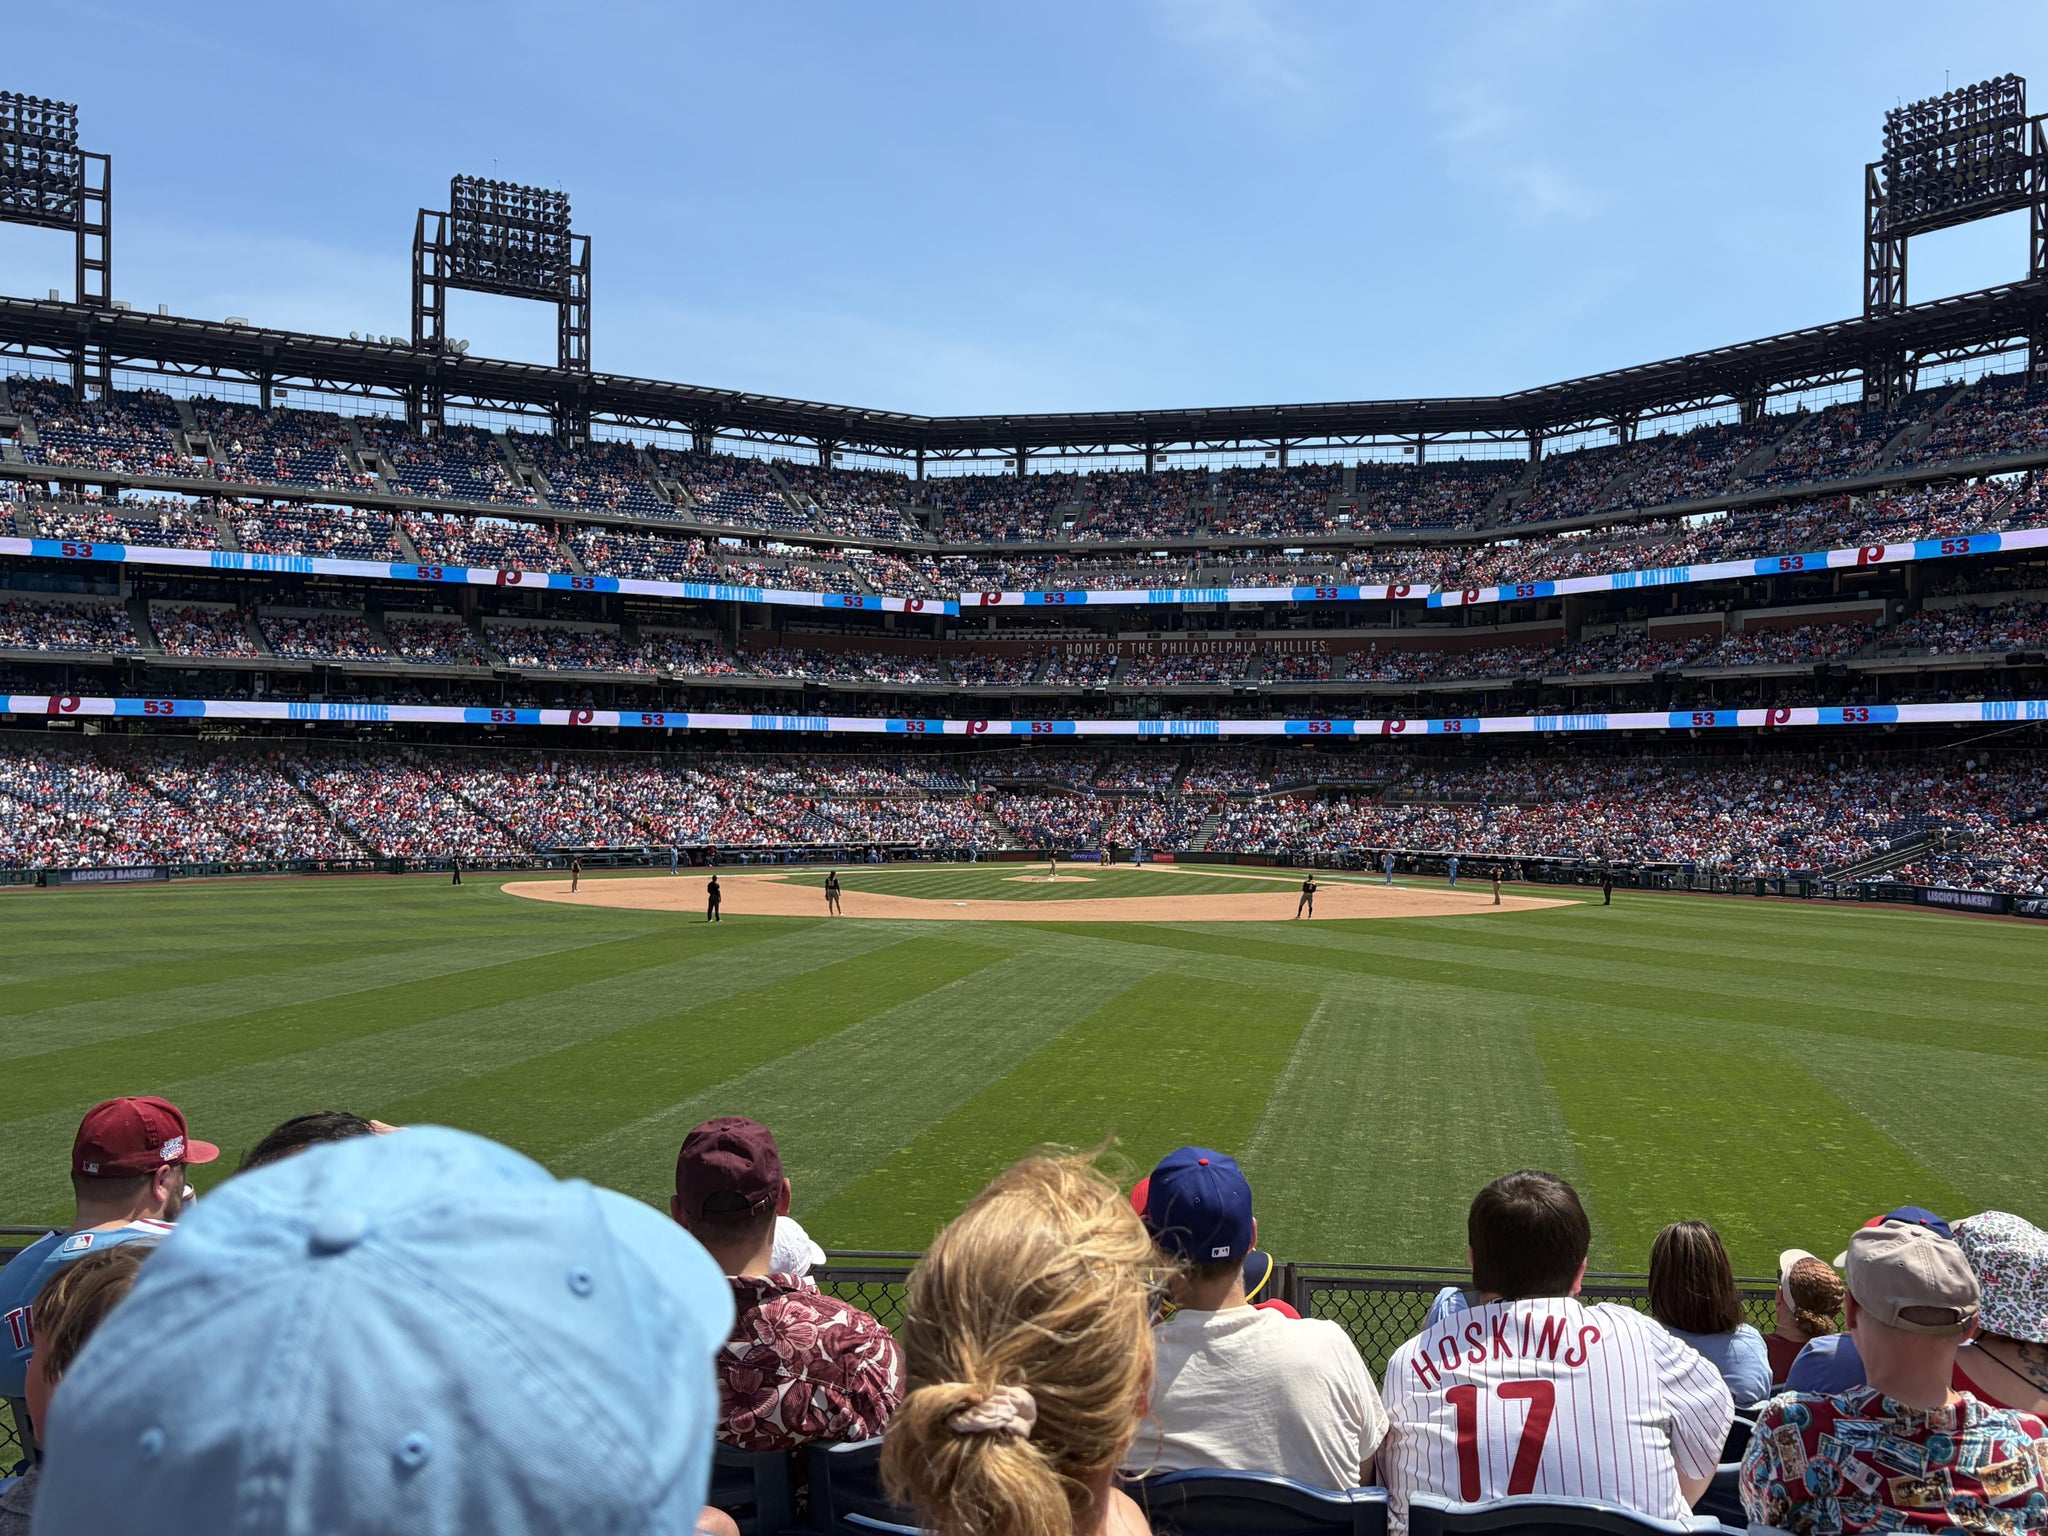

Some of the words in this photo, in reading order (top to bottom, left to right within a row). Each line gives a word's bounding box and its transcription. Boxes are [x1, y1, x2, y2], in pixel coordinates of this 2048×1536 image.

[62, 543, 93, 558] 53
[1941, 539, 1969, 554] 53
[211, 552, 247, 567] NOW
[252, 555, 312, 573] BATTING
[1779, 556, 1803, 570] 53
[417, 567, 442, 579] 53
[1612, 571, 1636, 588] NOW
[1640, 567, 1689, 585] BATTING
[571, 577, 594, 588] 53
[684, 584, 709, 598] NOW
[716, 586, 763, 601] BATTING
[1149, 589, 1175, 602] NOW
[1180, 588, 1228, 602] BATTING
[1316, 588, 1338, 598] 53
[1516, 585, 1534, 597] 53
[844, 596, 862, 607] 53
[1044, 593, 1065, 603] 53
[1066, 642, 1101, 654] HOME
[1108, 642, 1123, 654] OF
[1131, 642, 1153, 654] THE
[1162, 641, 1257, 654] PHILADELPHIA
[145, 701, 174, 714] 53
[288, 703, 324, 718] NOW
[329, 704, 388, 720] BATTING
[1982, 702, 2020, 720] NOW
[491, 710, 516, 722] 53
[641, 714, 664, 726] 53
[1692, 713, 1714, 726] 53
[1843, 708, 1869, 722] 53
[752, 715, 781, 729] NOW
[785, 717, 828, 730] BATTING
[906, 721, 925, 732] 53
[1031, 722, 1052, 733] 53
[1139, 721, 1165, 734] NOW
[1170, 720, 1219, 734] BATTING
[1309, 722, 1332, 733] 53
[1443, 721, 1461, 732] 53
[1534, 716, 1557, 731] NOW
[1563, 714, 1607, 730] BATTING
[71, 870, 115, 881] LISCIO'S
[117, 868, 156, 879] BAKERY
[1927, 890, 1959, 903] LISCIO'S
[1960, 894, 1993, 907] BAKERY
[1411, 1312, 1601, 1391] HOSKINS
[1445, 1379, 1556, 1503] 17
